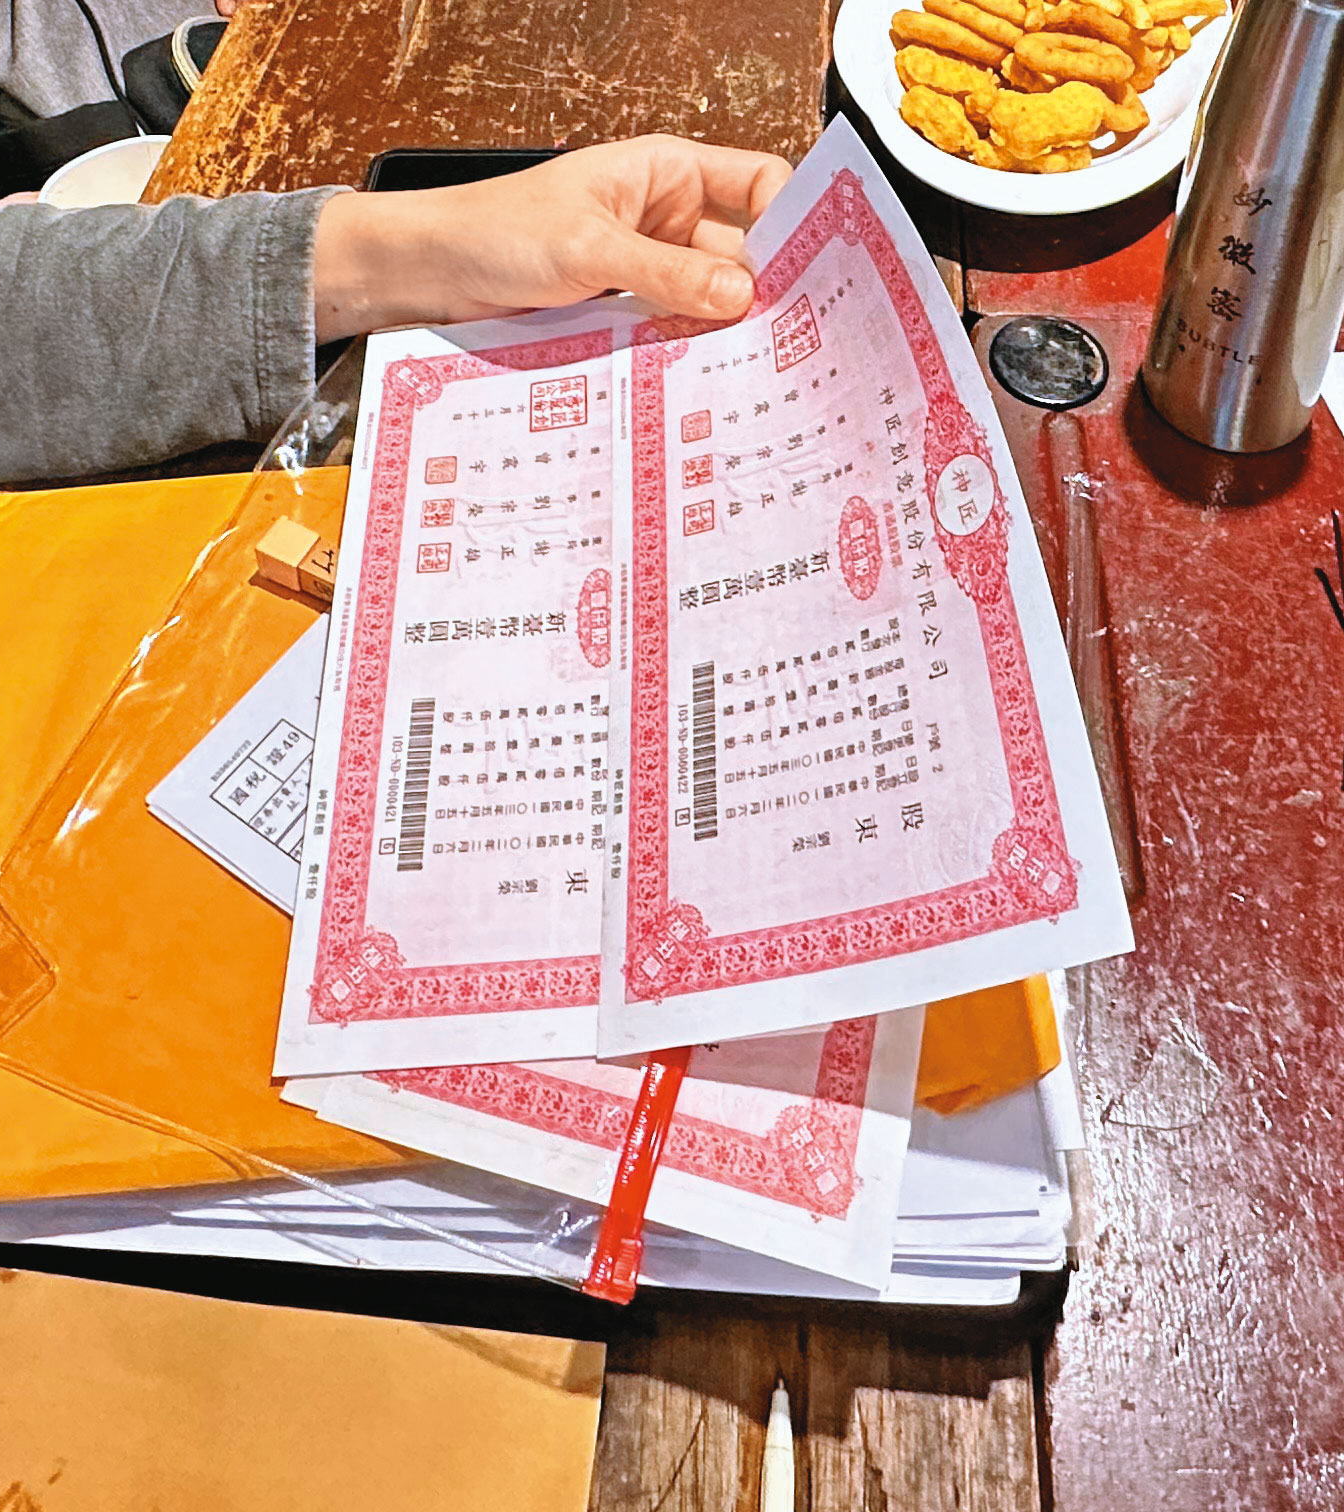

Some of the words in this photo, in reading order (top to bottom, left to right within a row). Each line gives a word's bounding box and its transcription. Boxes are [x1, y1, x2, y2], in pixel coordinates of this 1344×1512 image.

[466, 495, 552, 519] 劉宗榮
[951, 469, 984, 525] 神匠
[464, 540, 552, 565] 謝正雄
[877, 384, 948, 681] 神匠創意股份有限公司
[679, 549, 831, 611] 新臺幣壹萬圓整
[404, 610, 567, 645] 新臺幣壹萬圓整
[676, 704, 690, 795] 103-ND-0000422
[932, 762, 945, 774] 2
[229, 768, 268, 807] 國稅
[384, 735, 405, 824] 103-ND-0000421
[855, 802, 926, 844] 股東
